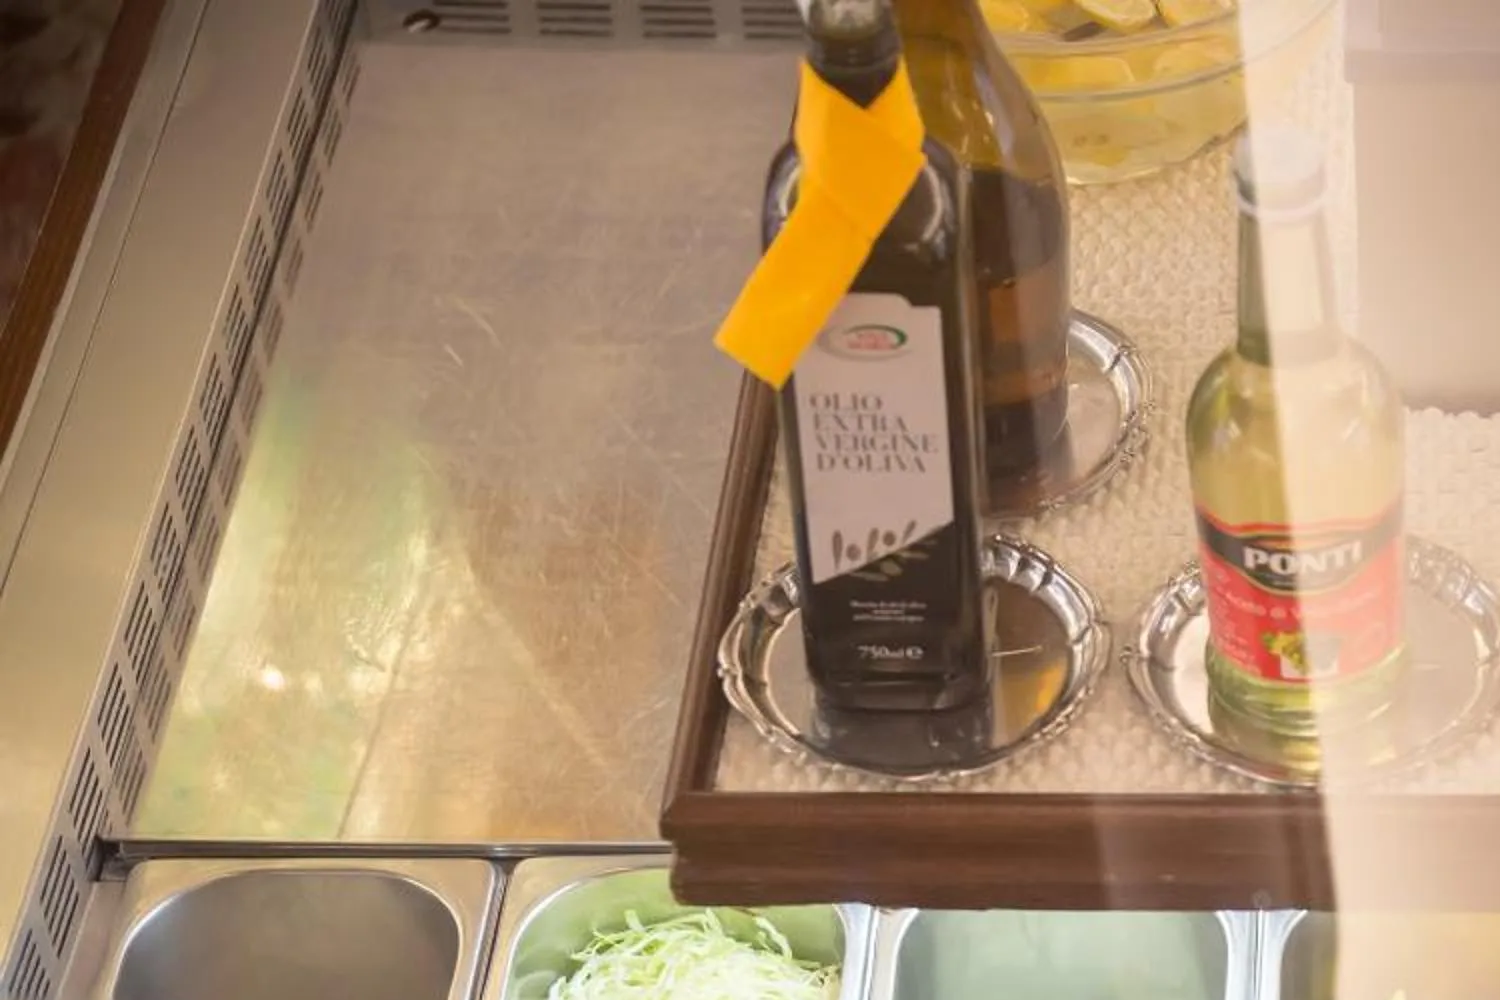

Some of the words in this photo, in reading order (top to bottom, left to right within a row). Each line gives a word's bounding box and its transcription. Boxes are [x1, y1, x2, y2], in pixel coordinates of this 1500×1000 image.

[809, 392, 883, 412] OLIO
[812, 412, 909, 432] EXTRA
[814, 432, 941, 453] VERGINE
[816, 452, 927, 474] D'OLIVA
[1243, 540, 1363, 576] PONTI
